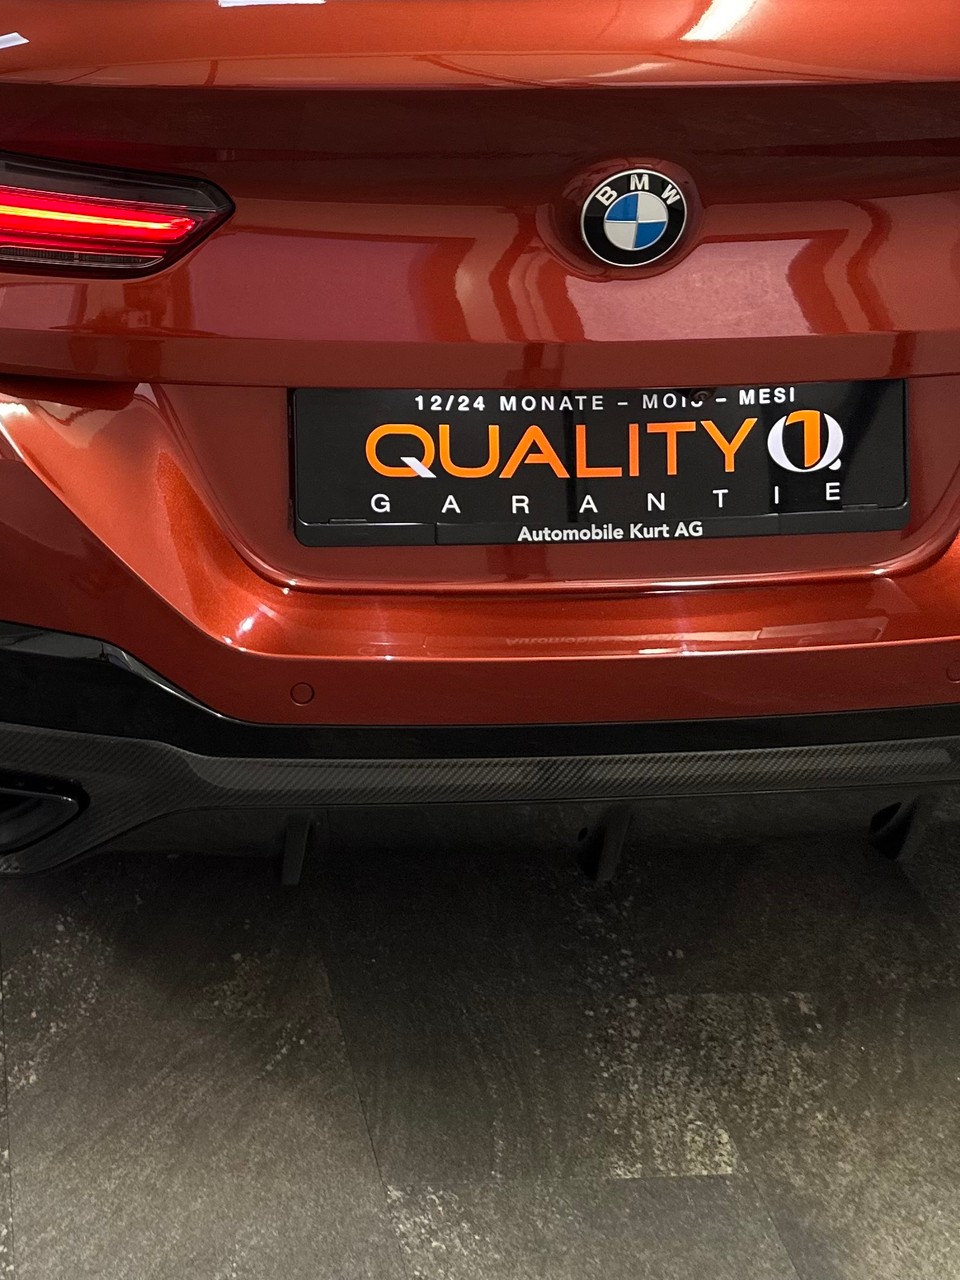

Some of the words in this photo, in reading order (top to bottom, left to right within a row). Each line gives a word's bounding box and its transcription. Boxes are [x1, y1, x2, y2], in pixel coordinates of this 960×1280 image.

[595, 173, 681, 207] BMW
[414, 394, 486, 412] 12/24
[499, 394, 604, 412] MONATE
[739, 386, 795, 406] MESI
[365, 417, 758, 479] QUALITY
[370, 482, 841, 514] GARANTIE
[517, 523, 625, 542] Automobile
[629, 522, 670, 539] Kurt
[674, 520, 704, 538] AG
